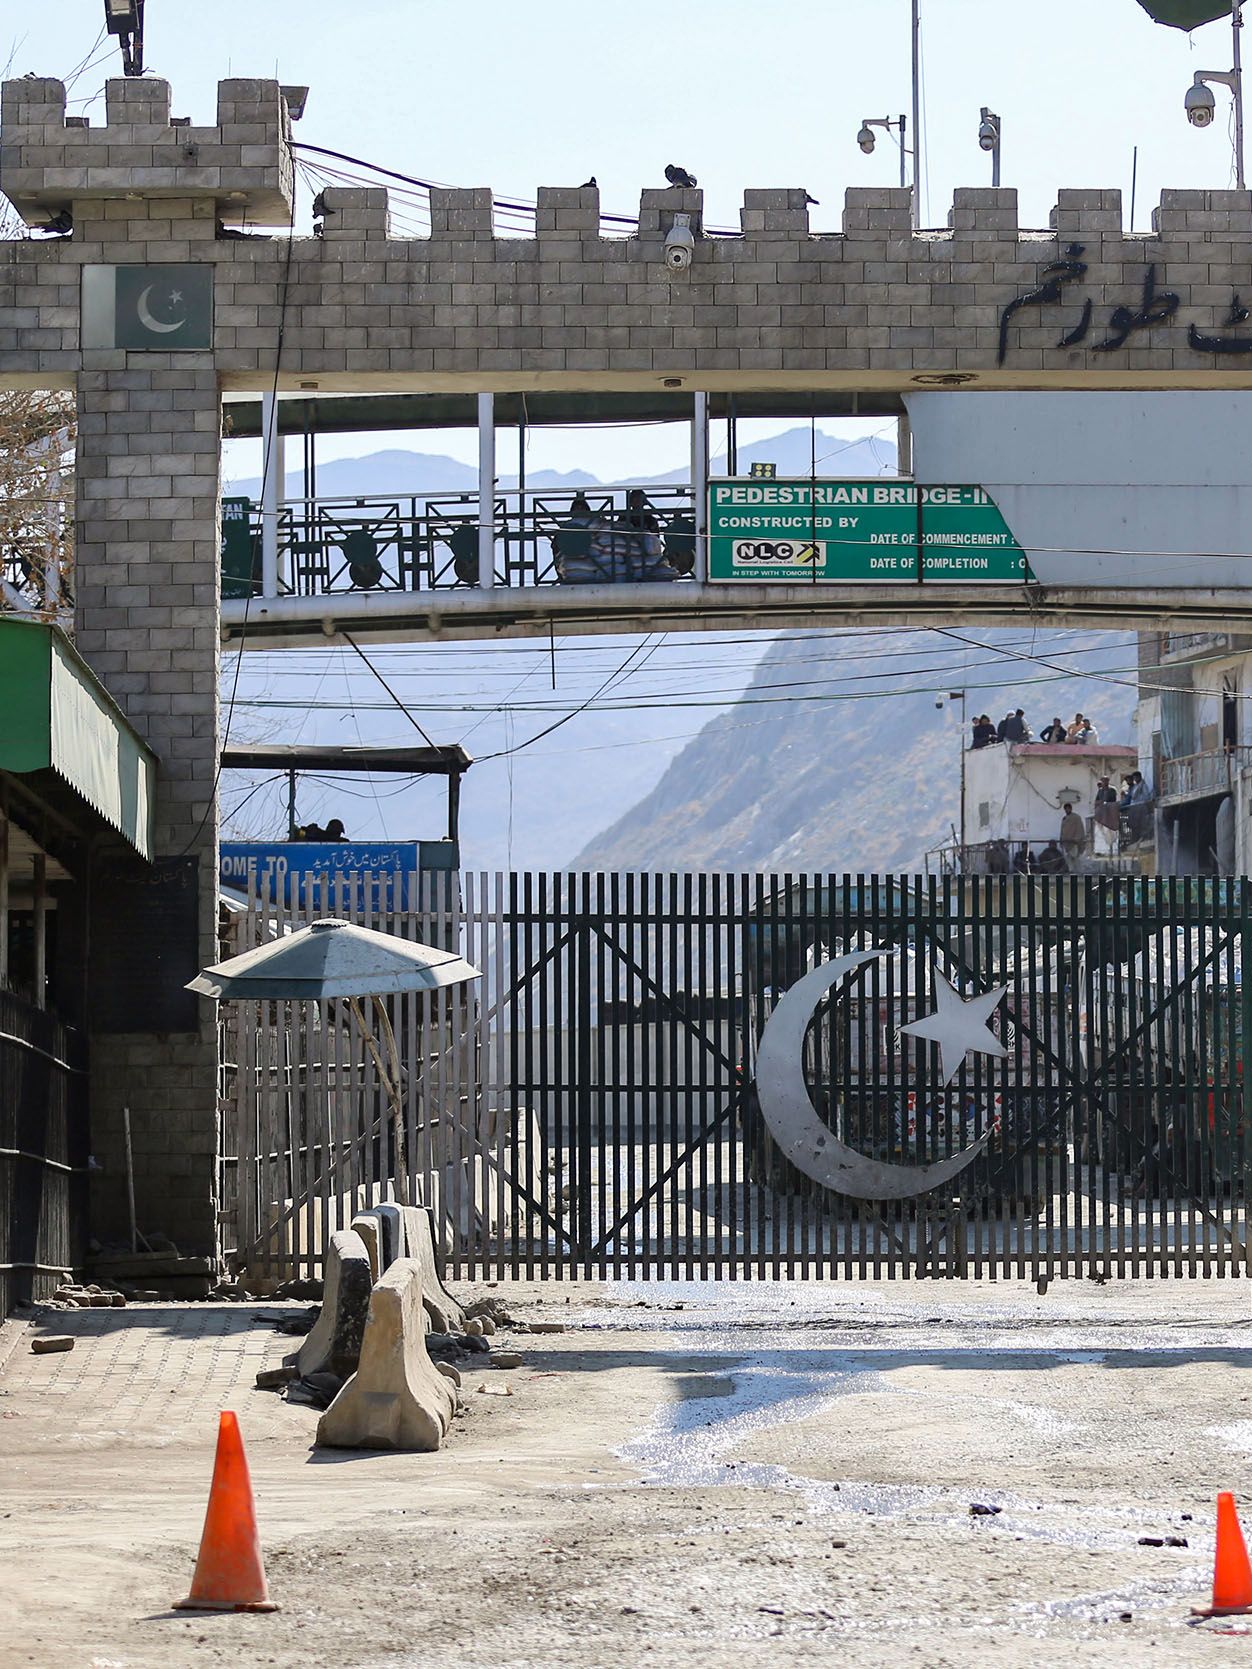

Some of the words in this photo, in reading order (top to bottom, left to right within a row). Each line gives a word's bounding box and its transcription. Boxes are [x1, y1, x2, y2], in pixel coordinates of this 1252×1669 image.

[997, 243, 1180, 368] طورخم
[716, 487, 868, 504] PEDESTRIAN
[718, 517, 833, 528] CONSTRUCTED
[838, 517, 859, 528] BY
[870, 533, 898, 544] DATE
[901, 533, 916, 544] OF
[739, 544, 791, 558] NLC
[870, 558, 897, 569] DATE
[900, 558, 915, 569] OF
[313, 852, 338, 869] آمدید
[370, 850, 401, 870] پاکستان
